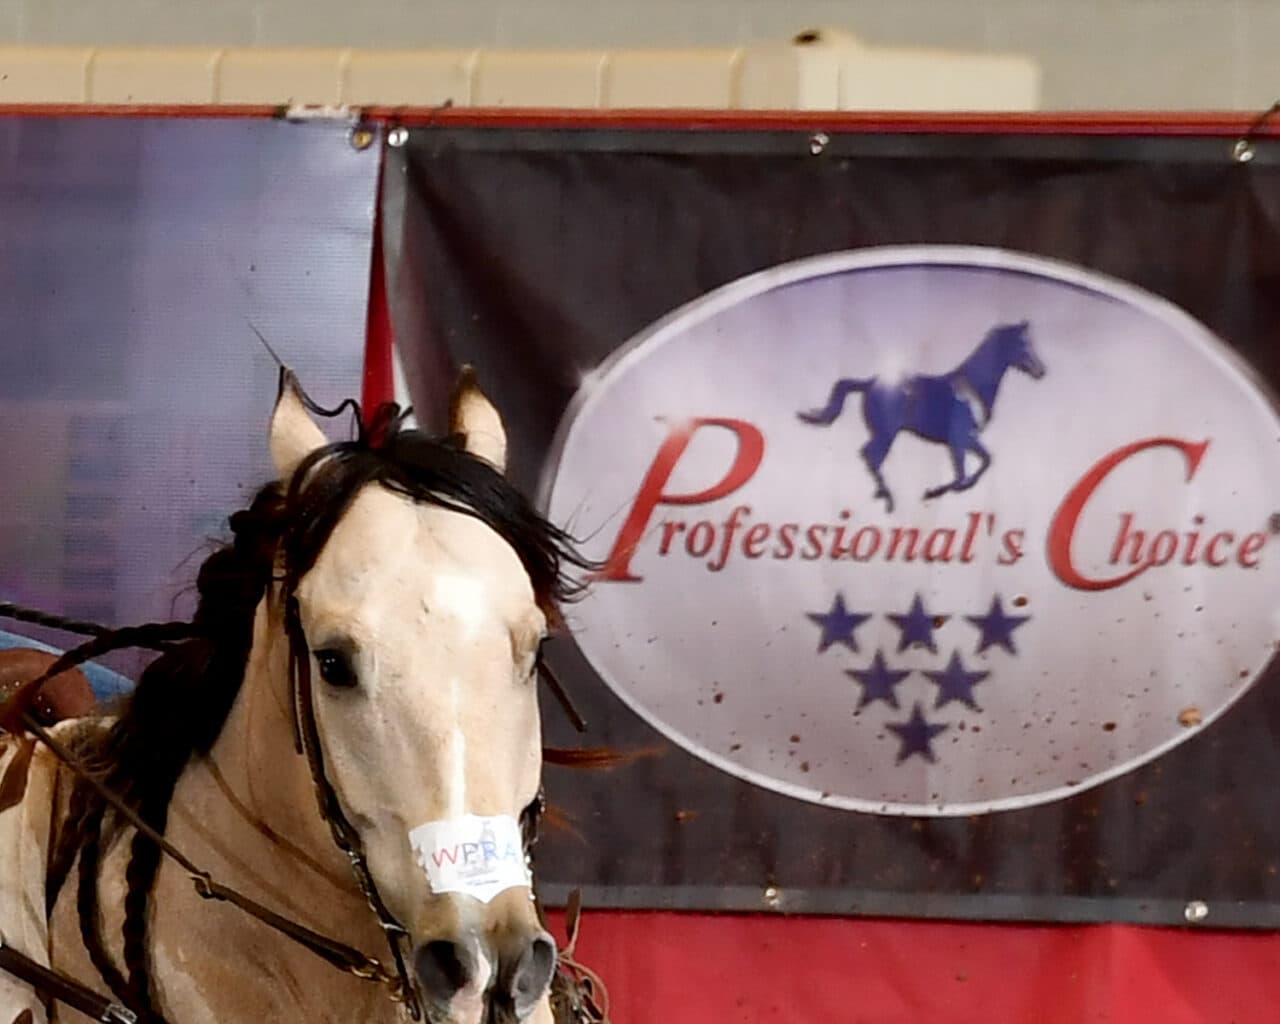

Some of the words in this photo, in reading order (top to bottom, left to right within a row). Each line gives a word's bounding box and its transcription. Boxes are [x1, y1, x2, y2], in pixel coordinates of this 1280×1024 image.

[583, 416, 1026, 583] Professional's
[1046, 436, 1268, 593] Choice
[431, 841, 519, 868] WPRA
